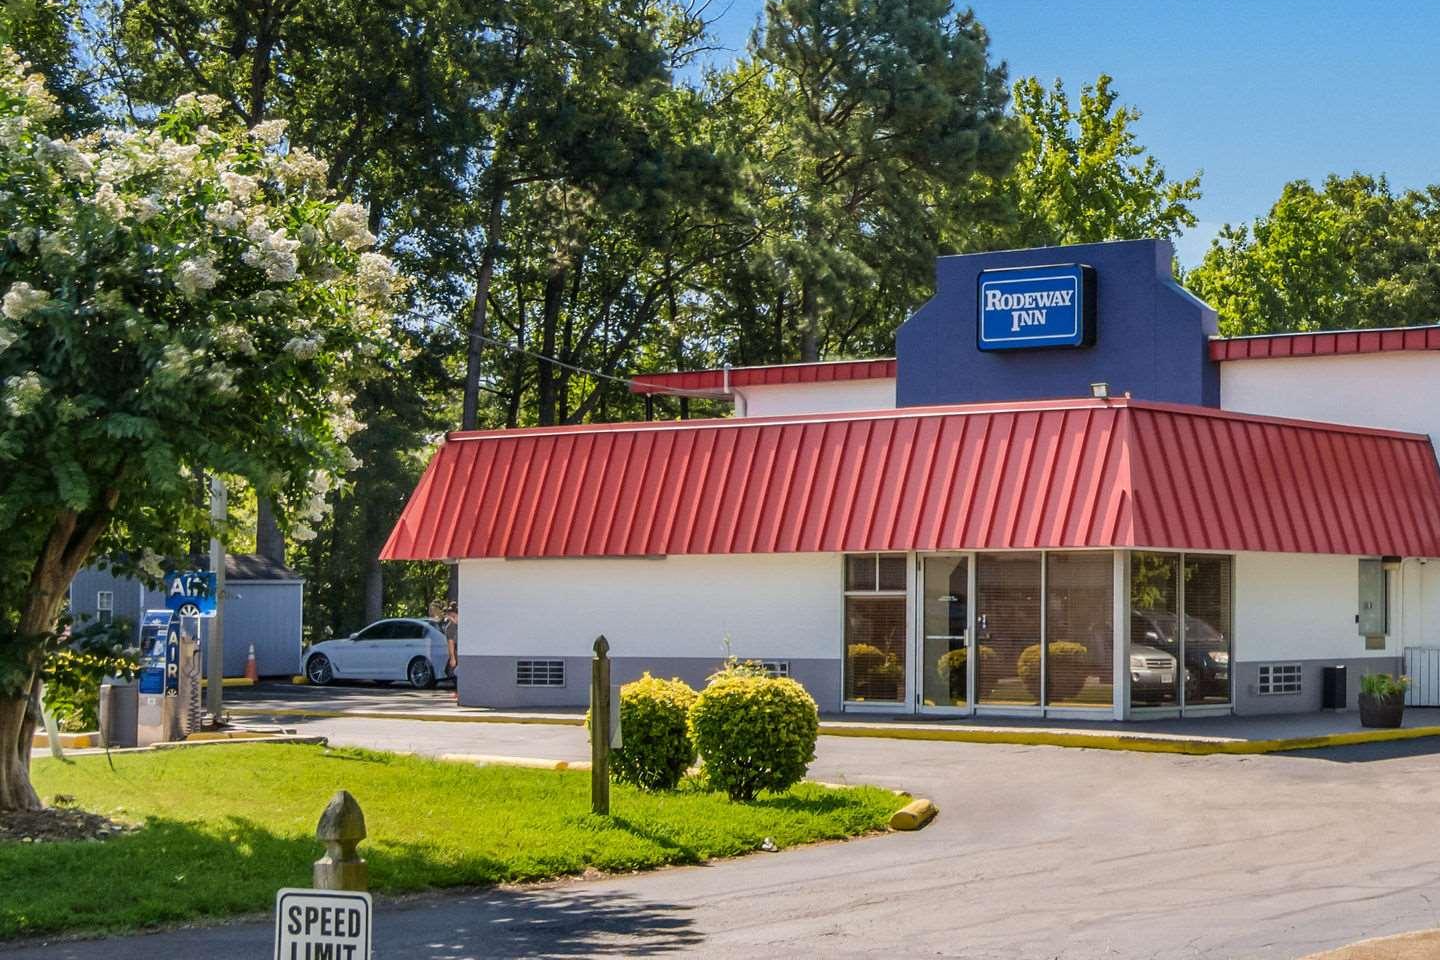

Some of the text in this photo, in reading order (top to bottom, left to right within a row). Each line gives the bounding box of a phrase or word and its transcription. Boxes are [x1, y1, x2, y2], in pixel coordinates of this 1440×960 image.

[985, 289, 1074, 311] RODEWAY
[1011, 309, 1047, 332] INN
[167, 631, 178, 678] AIR
[287, 905, 361, 938] SPEED
